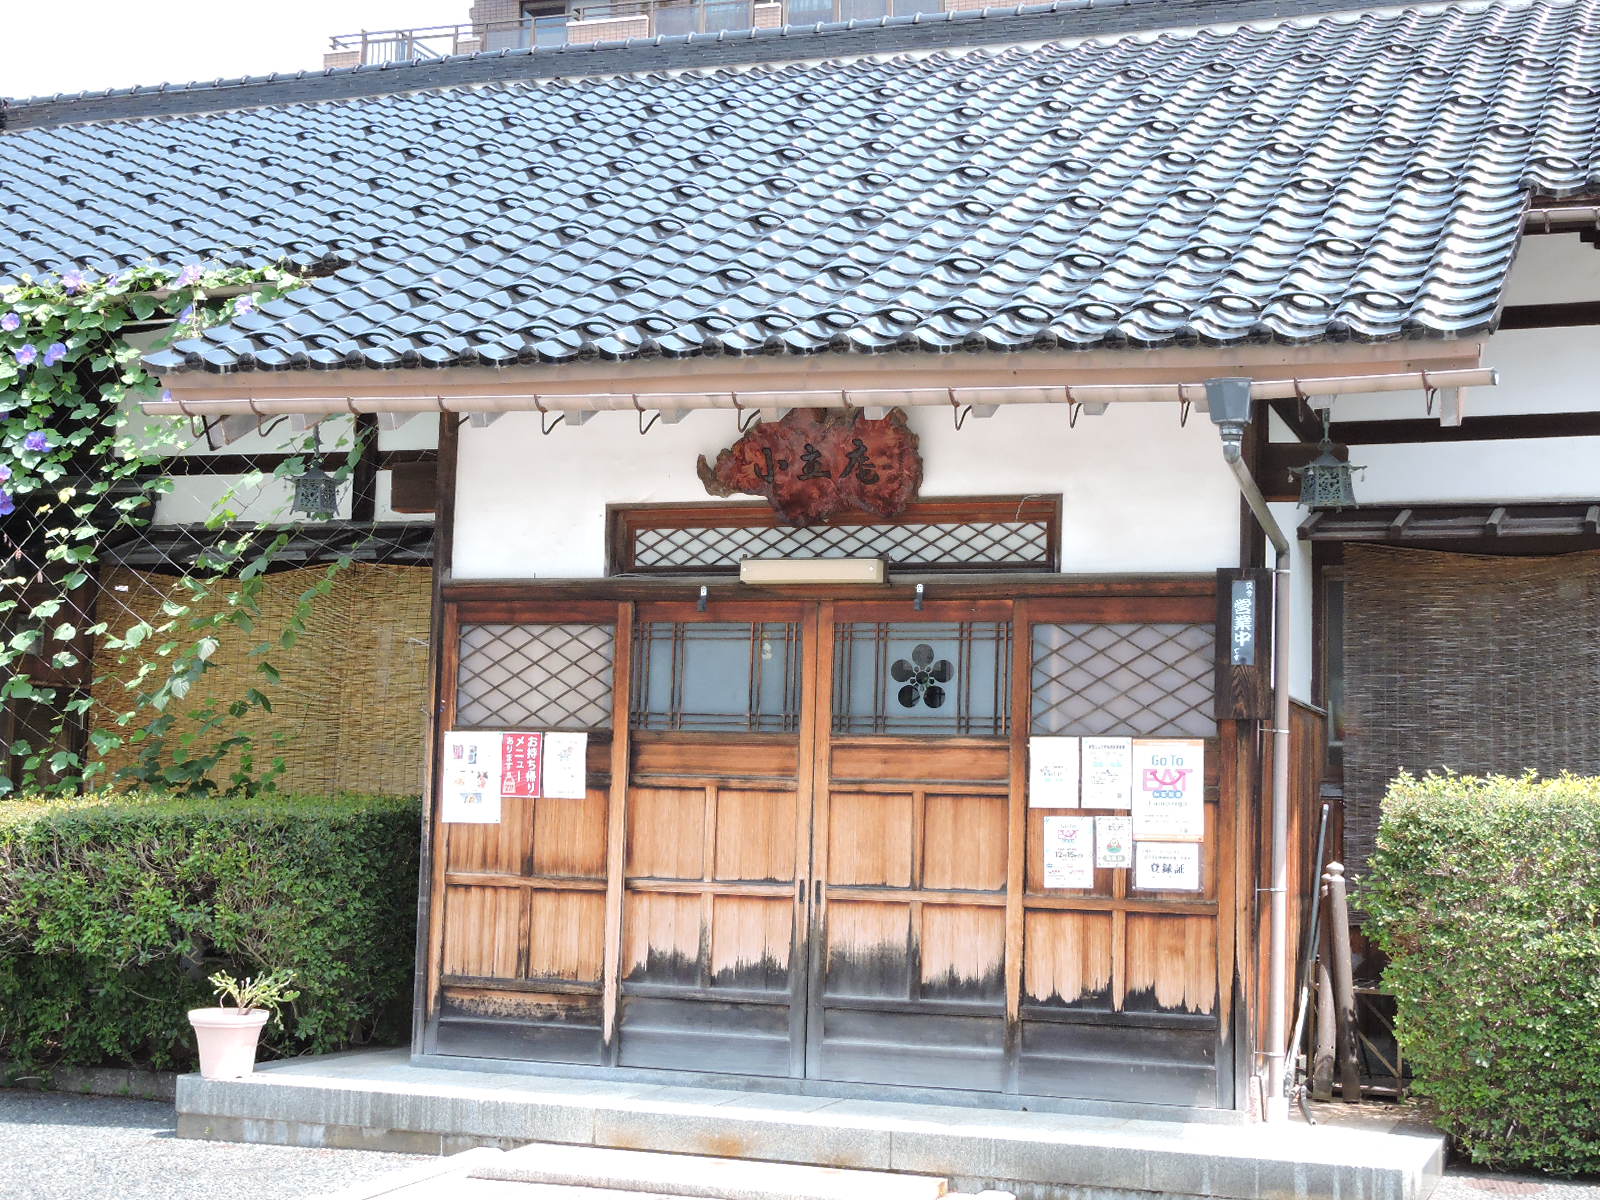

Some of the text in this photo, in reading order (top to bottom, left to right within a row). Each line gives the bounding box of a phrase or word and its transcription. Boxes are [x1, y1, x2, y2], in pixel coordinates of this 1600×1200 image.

[754, 438, 880, 485] 小立庵
[1233, 599, 1252, 647] 営業中
[505, 737, 513, 769] あります
[514, 735, 525, 782] メニュー
[526, 736, 538, 793] お持ち帰り
[1151, 754, 1184, 767] Go To
[1143, 768, 1193, 792] EAT
